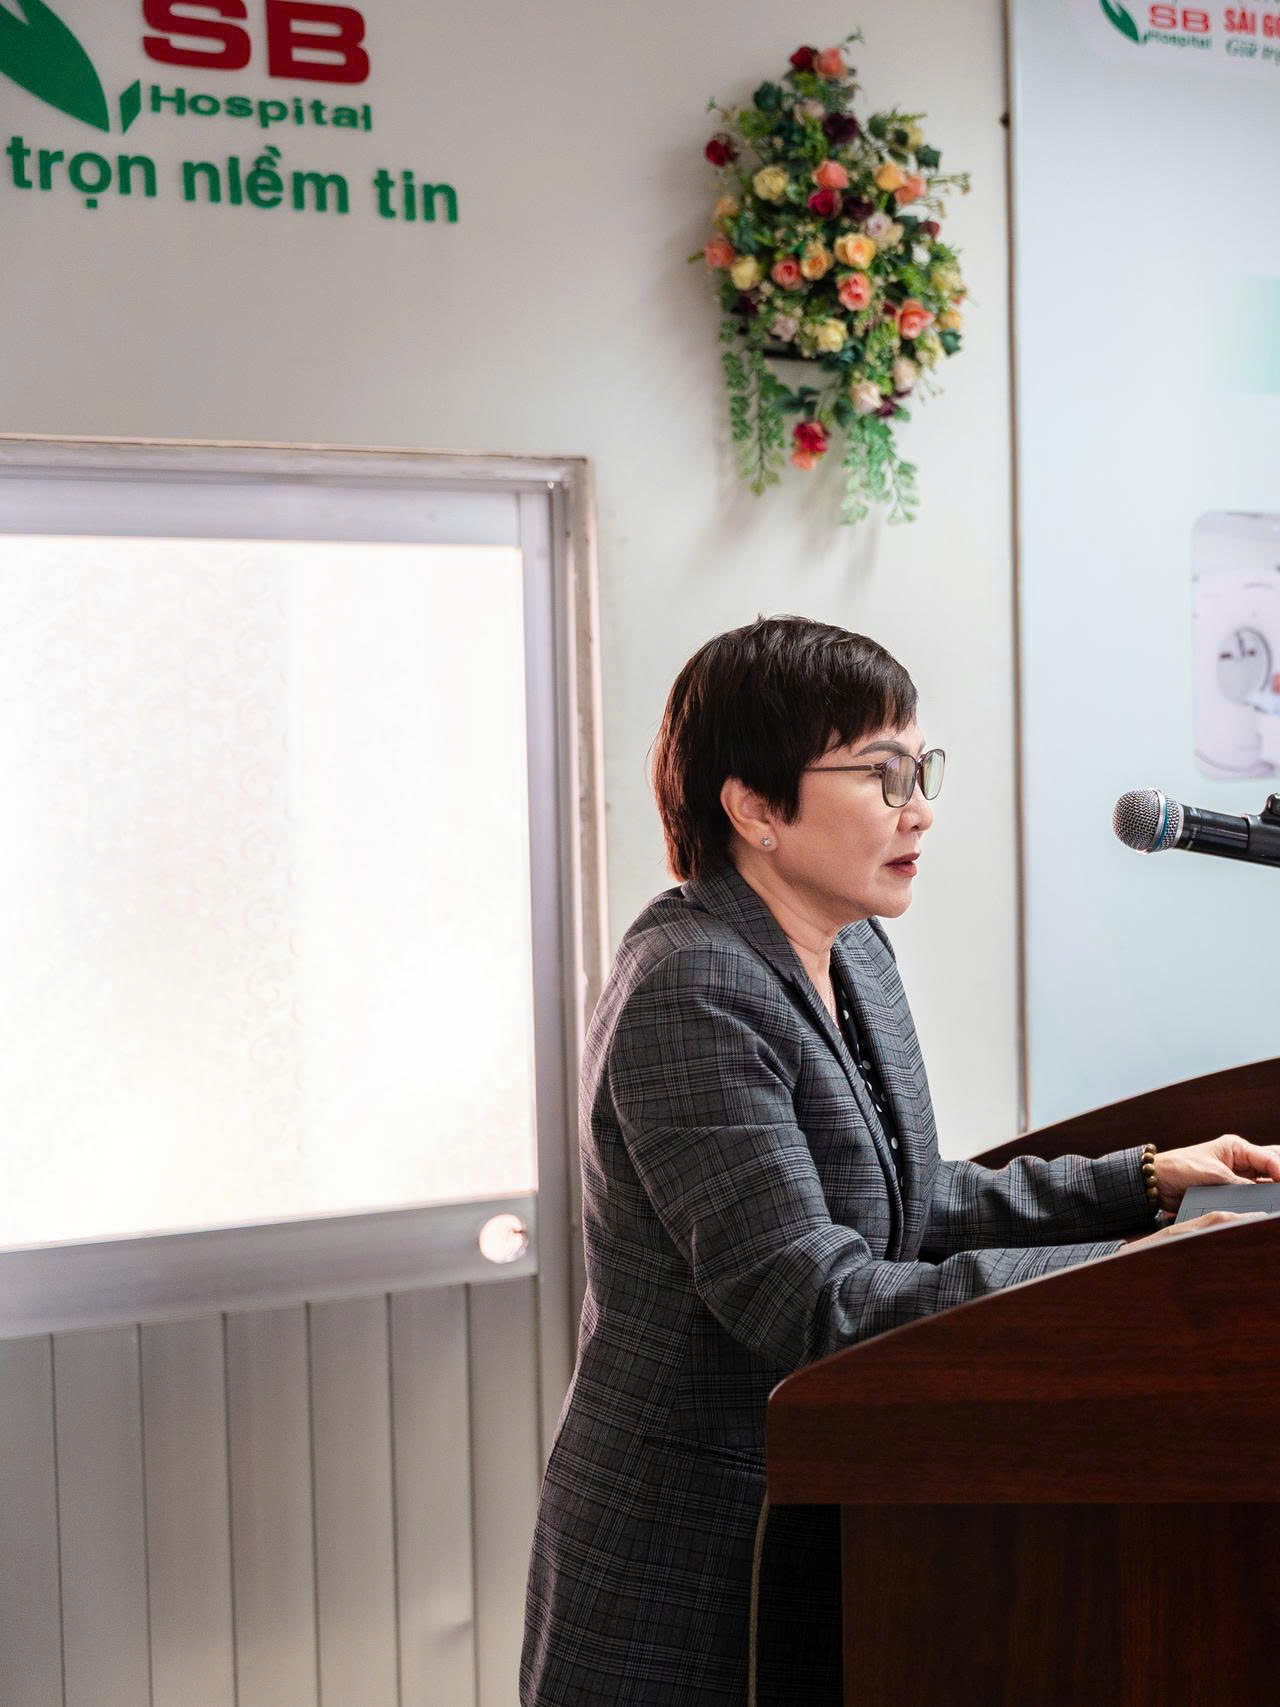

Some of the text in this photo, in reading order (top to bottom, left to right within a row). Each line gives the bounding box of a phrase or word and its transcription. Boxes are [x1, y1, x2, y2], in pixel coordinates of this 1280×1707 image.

[142, 0, 370, 85] SB
[1149, 5, 1210, 33] SB
[1223, 7, 1257, 35] SÀI
[150, 84, 373, 131] Hospital
[6, 136, 158, 209] trọn
[373, 168, 459, 223] tin
